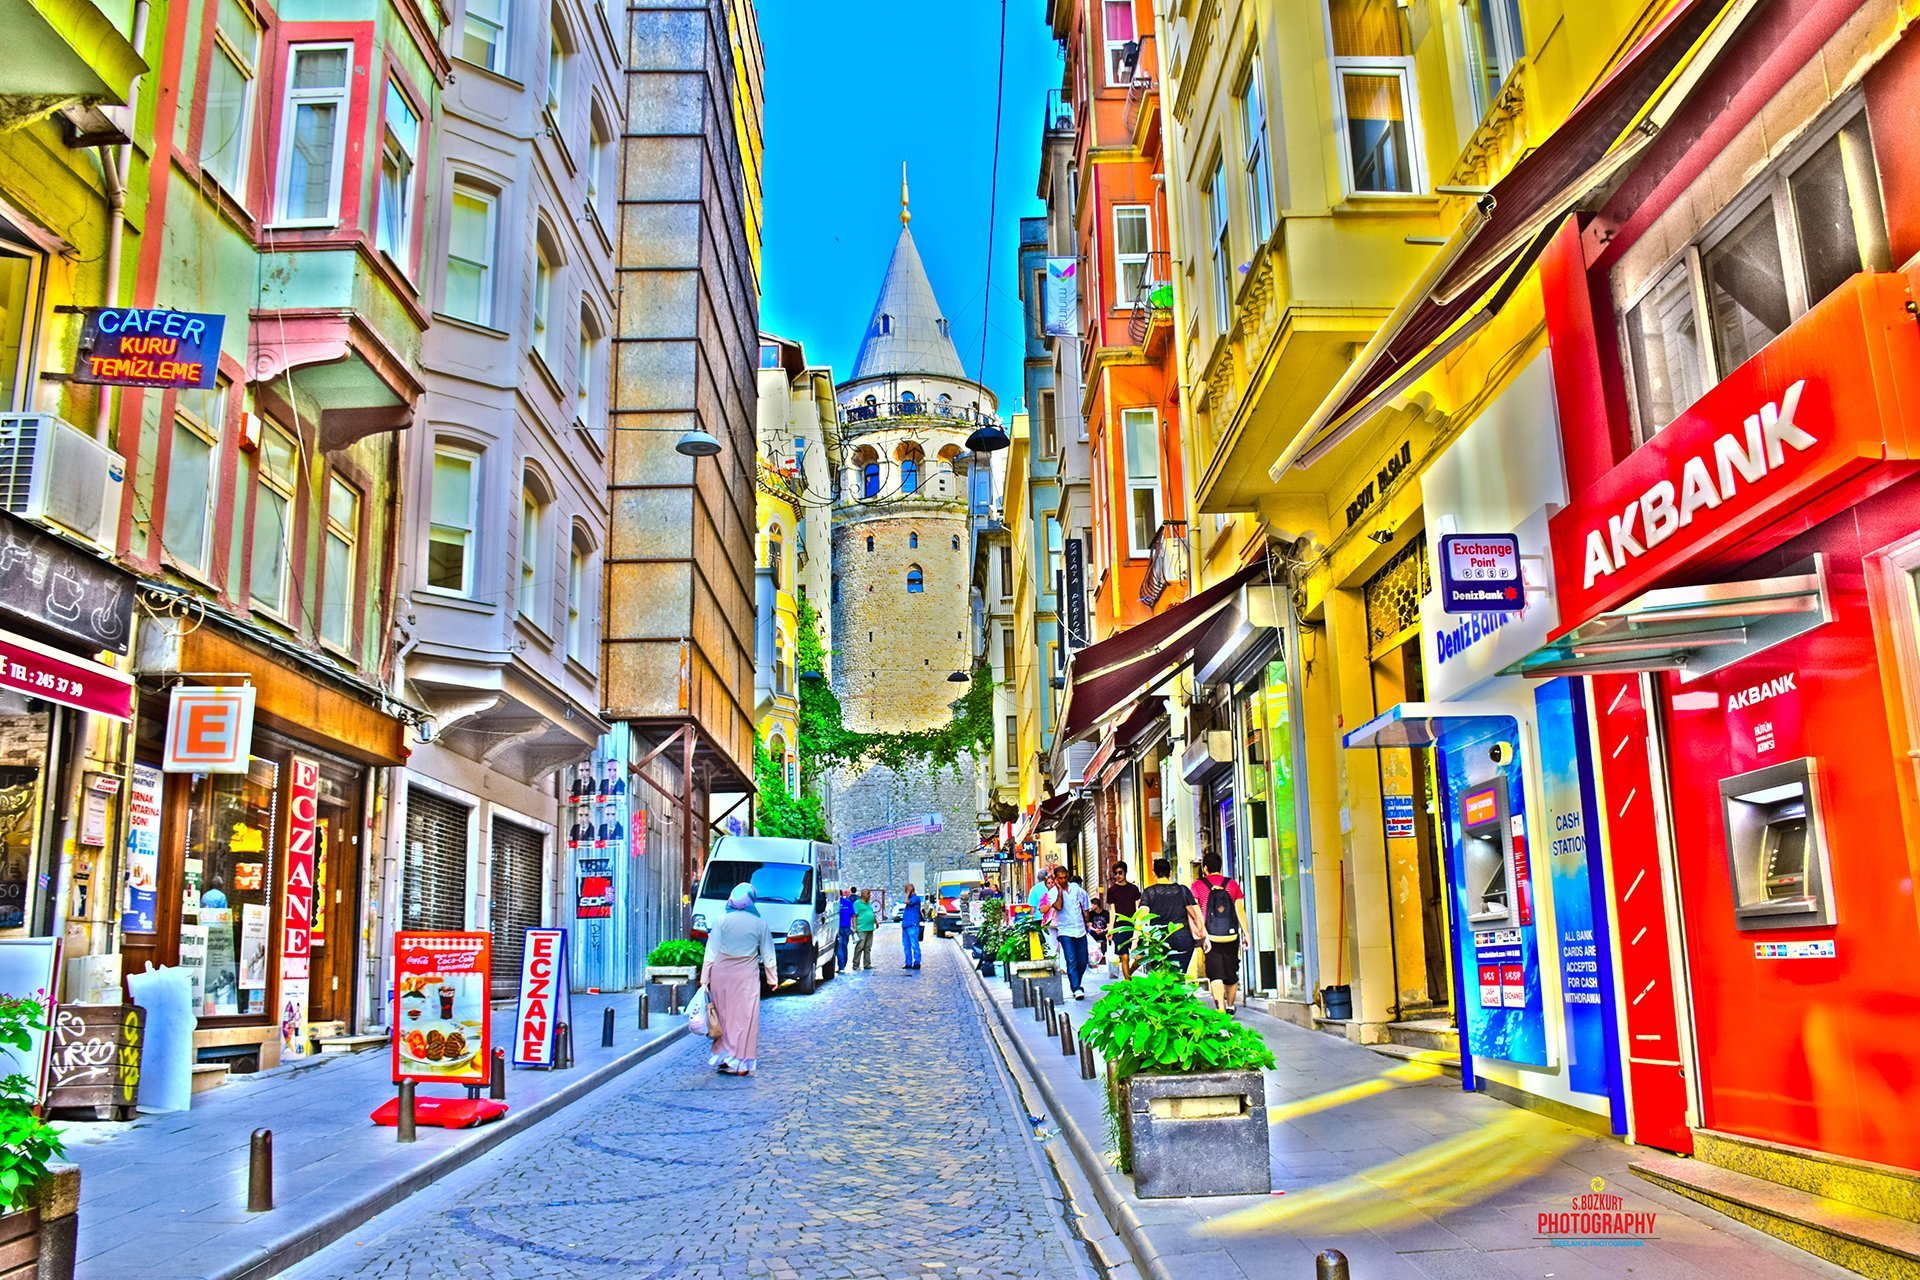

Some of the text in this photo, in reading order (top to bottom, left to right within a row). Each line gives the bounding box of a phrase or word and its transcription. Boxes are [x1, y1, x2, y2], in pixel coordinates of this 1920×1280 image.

[98, 309, 206, 344] CAFER
[120, 337, 177, 355] KURU
[90, 356, 202, 382] TEMİZLEME
[1584, 379, 1818, 590] AKBANK
[1346, 481, 1374, 527] ERSOY
[1069, 542, 1079, 584] GALATA
[1453, 543, 1512, 558] Exchange
[1470, 556, 1496, 569] Point
[1452, 590, 1504, 600] DenizBank
[36, 671, 54, 688] 245
[56, 677, 69, 693] 37
[70, 681, 83, 697] 39
[1727, 672, 1797, 713] AKBANK
[186, 705, 228, 755] E
[1556, 811, 1580, 831] CASH
[127, 829, 138, 853] 4
[286, 760, 317, 955] ECZANE
[1564, 929, 1593, 942] ALL BANK
[1563, 945, 1597, 957] CARDS ARE
[1566, 961, 1597, 973] ACCEPTED
[1568, 977, 1598, 988] FOR CASH
[523, 938, 553, 1062] ECZANE
